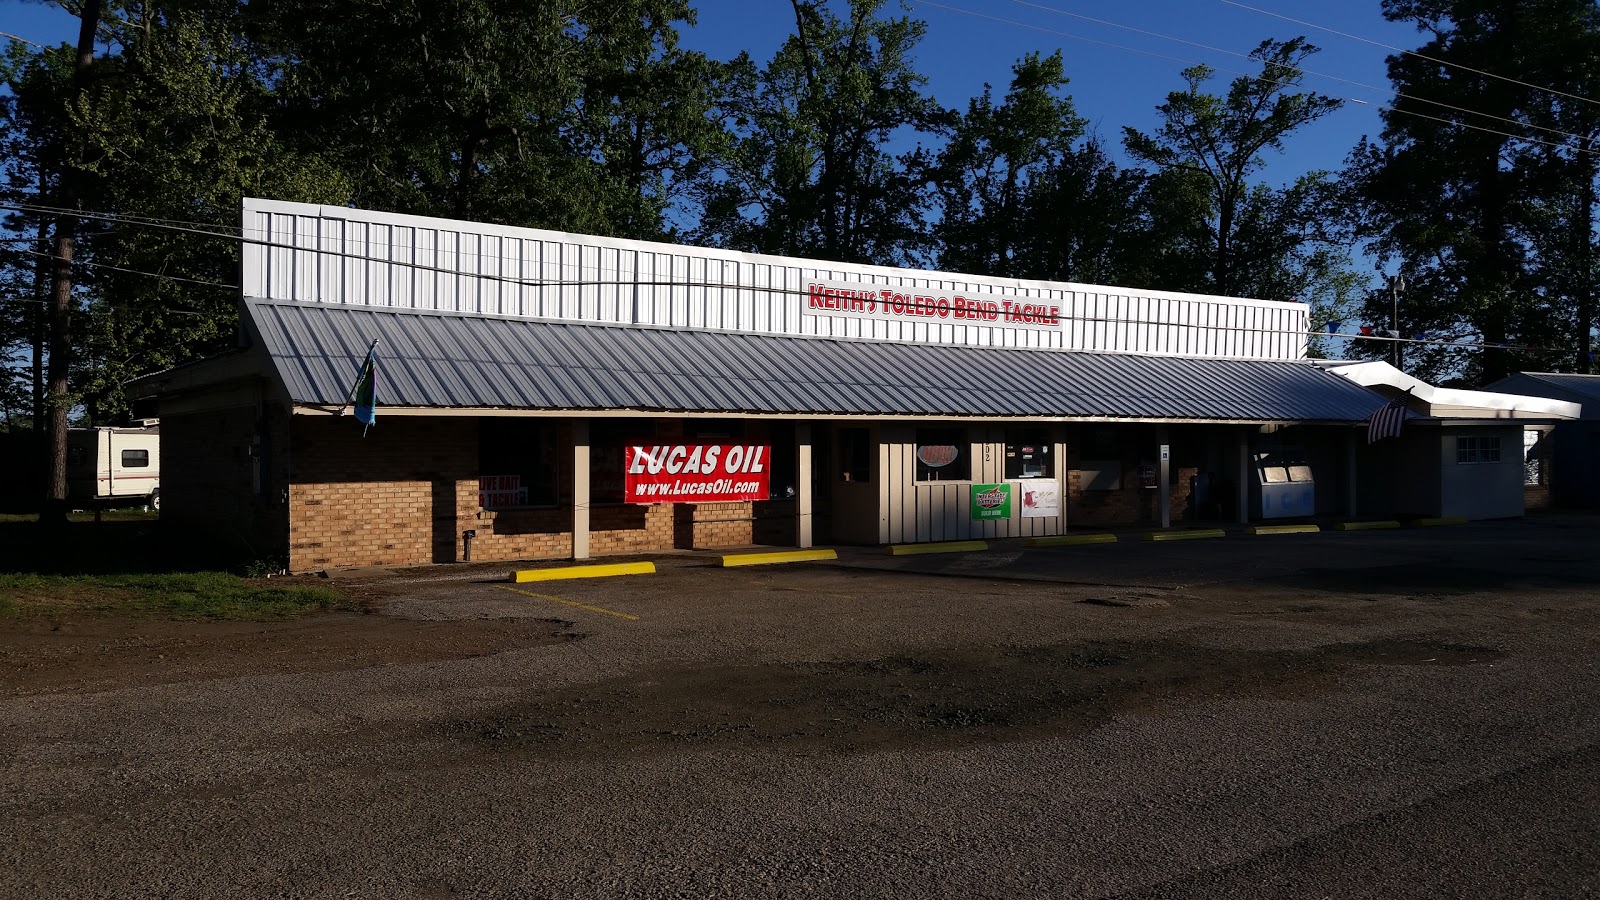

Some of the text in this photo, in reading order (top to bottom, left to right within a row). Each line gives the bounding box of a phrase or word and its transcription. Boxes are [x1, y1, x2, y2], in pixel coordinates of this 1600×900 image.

[808, 284, 1060, 325] KEITH'S TOLEDO BEND TACKLE
[629, 445, 721, 474] LUCAS
[725, 445, 764, 473] OIL
[635, 478, 760, 496] www.LucasOil.com
